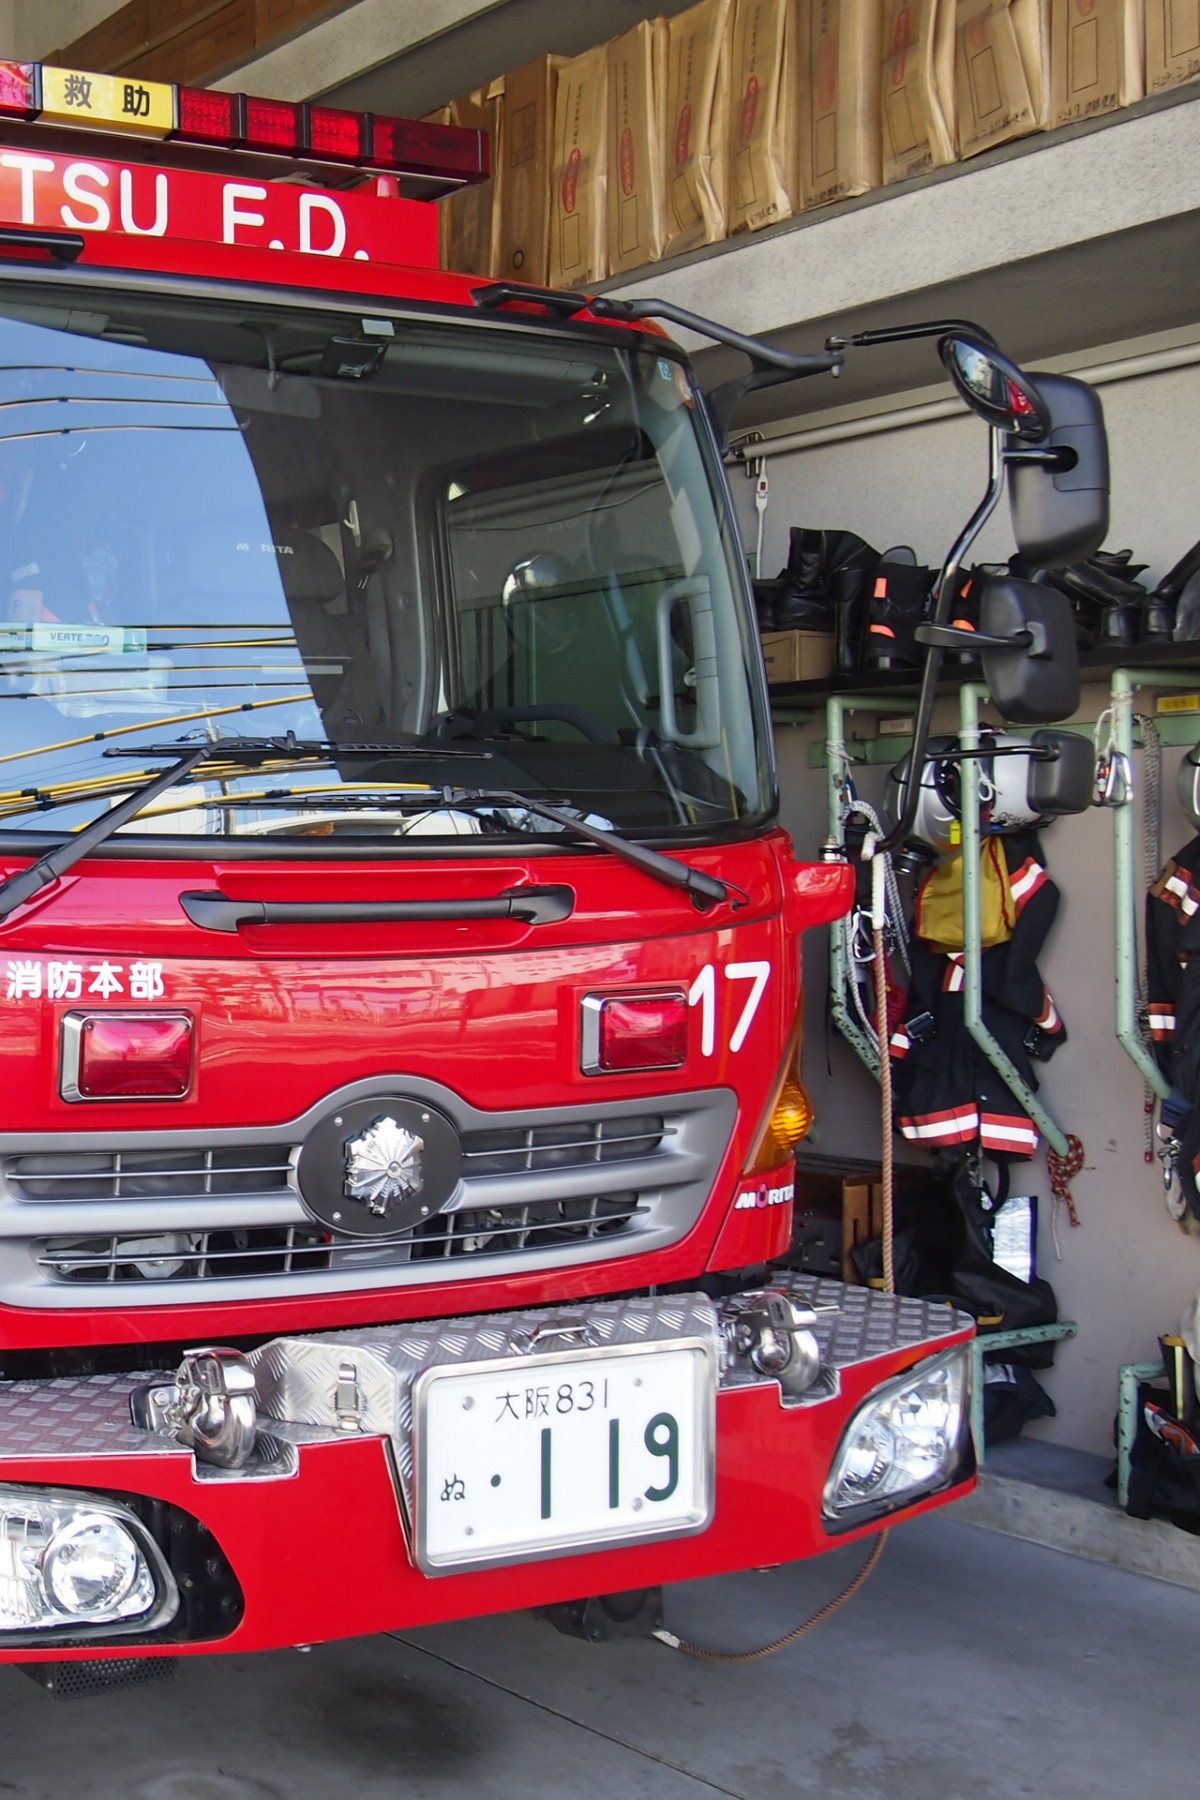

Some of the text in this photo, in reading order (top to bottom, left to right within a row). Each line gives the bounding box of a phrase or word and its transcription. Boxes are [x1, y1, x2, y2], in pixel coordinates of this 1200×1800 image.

[64, 74, 151, 117] 救助
[222, 184, 371, 261] F.D.
[236, 542, 294, 555] MRITA
[688, 960, 770, 1057] 17
[440, 1474, 466, 1502] ぬ
